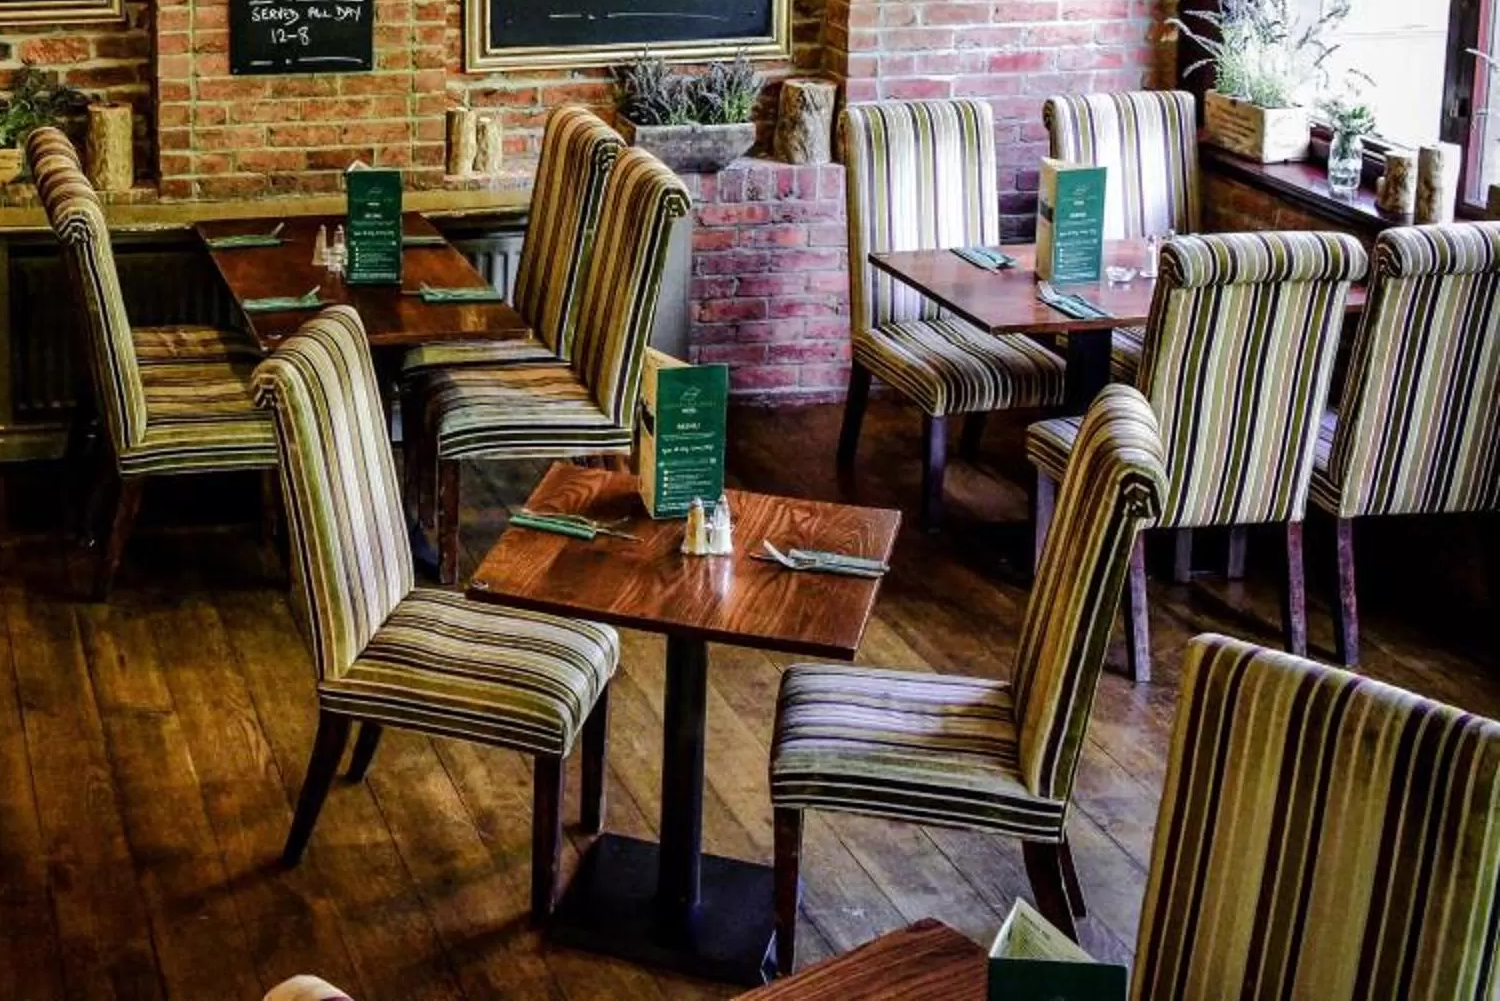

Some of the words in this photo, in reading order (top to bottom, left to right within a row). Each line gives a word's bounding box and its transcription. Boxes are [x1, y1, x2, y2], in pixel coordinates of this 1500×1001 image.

[251, 6, 299, 26] SERVED
[307, 6, 333, 20] ALL
[334, 6, 361, 22] DAY
